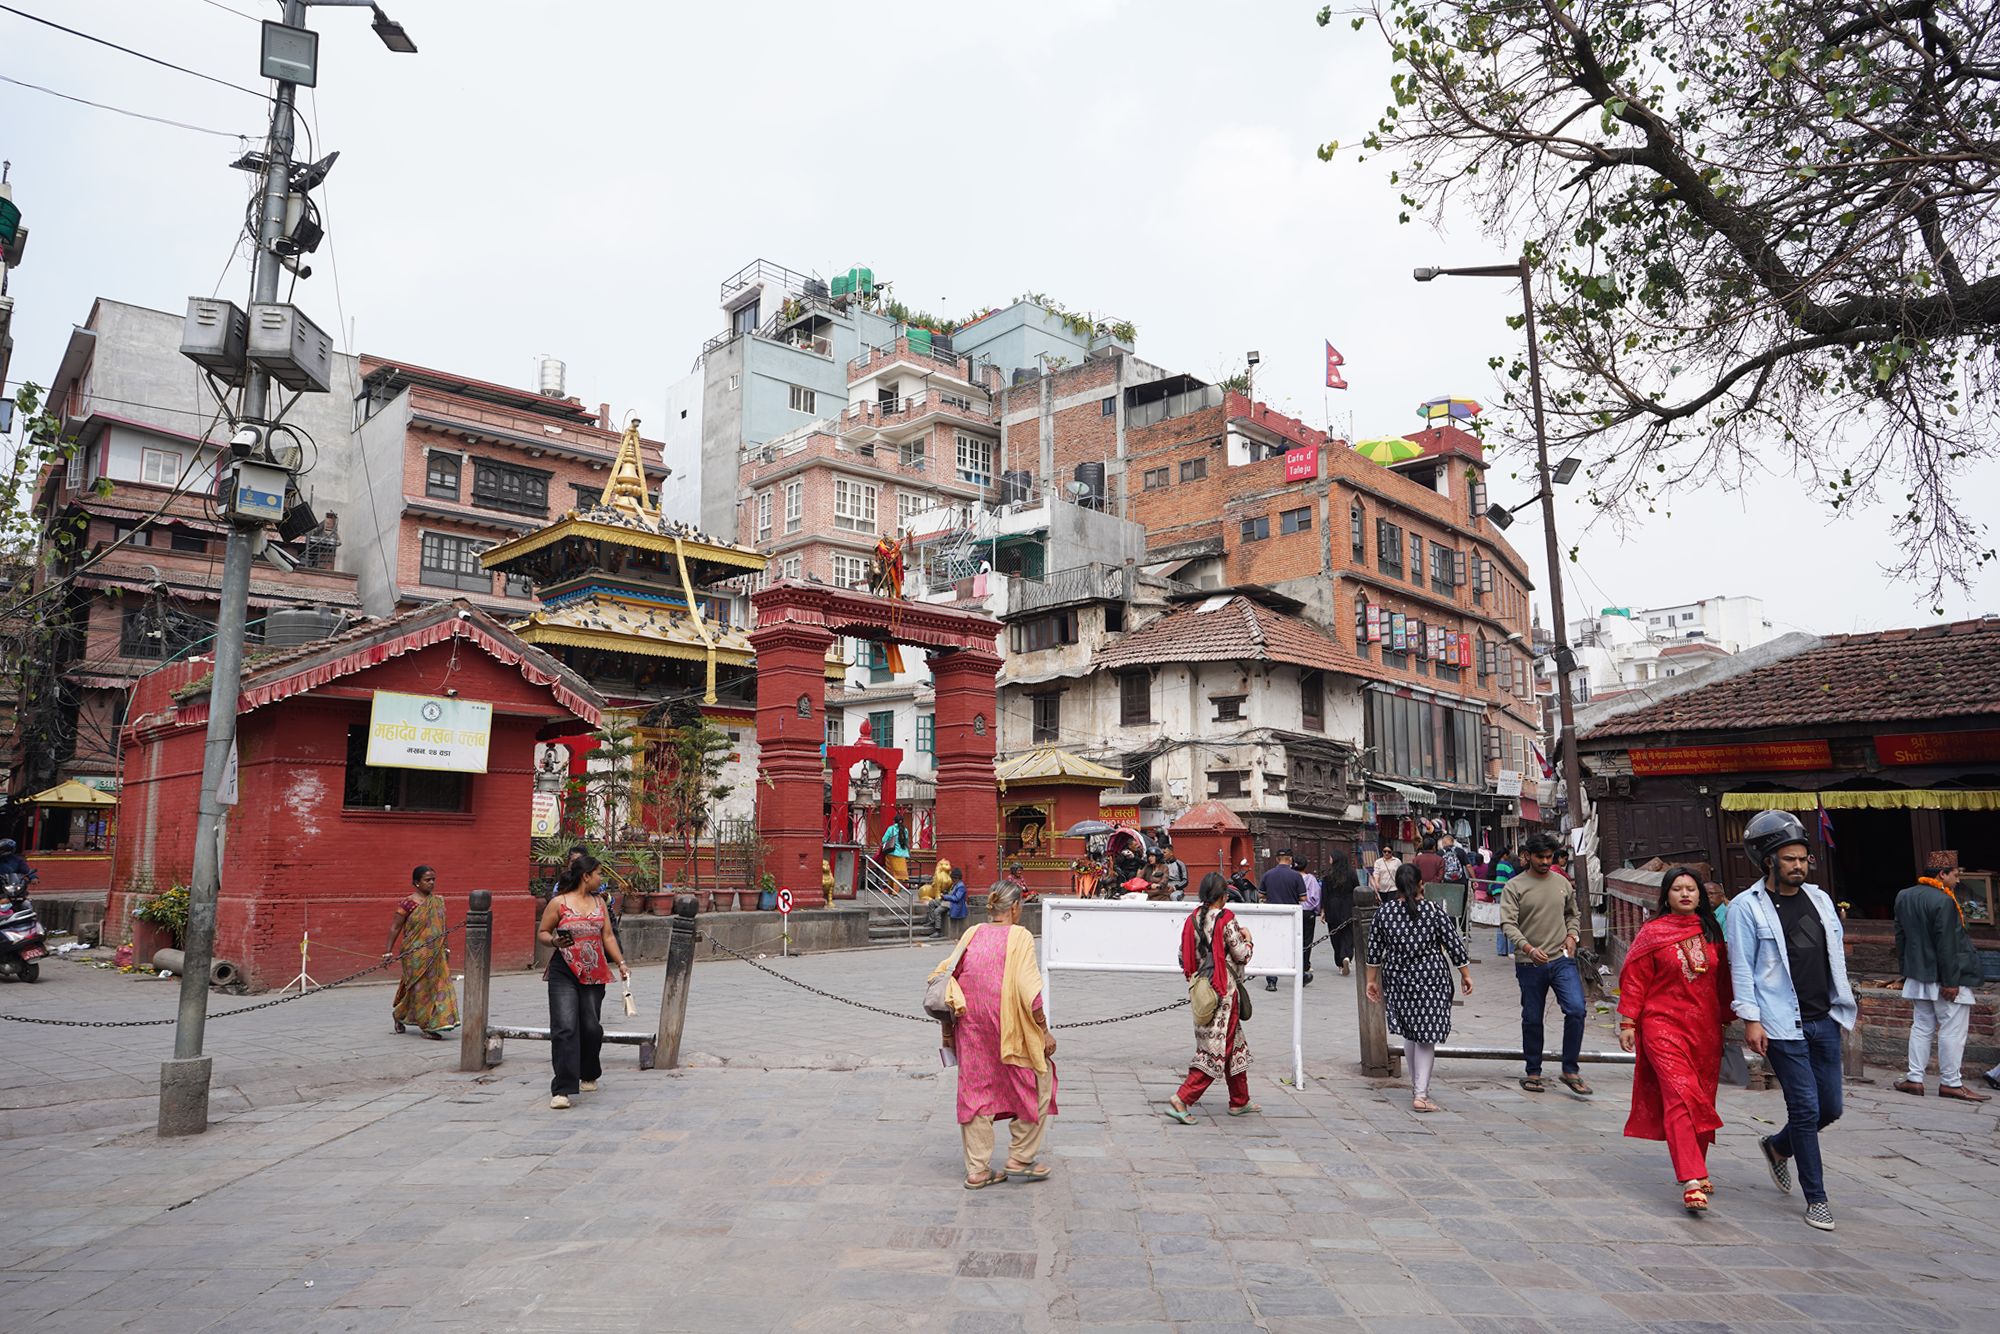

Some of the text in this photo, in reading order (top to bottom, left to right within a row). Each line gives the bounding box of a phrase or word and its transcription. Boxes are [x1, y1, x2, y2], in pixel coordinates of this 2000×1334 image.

[1288, 452, 1304, 464] Cafe
[1290, 464, 1310, 474] Taleju
[374, 720, 417, 741] महादेव
[1894, 749, 1924, 762] Shri
